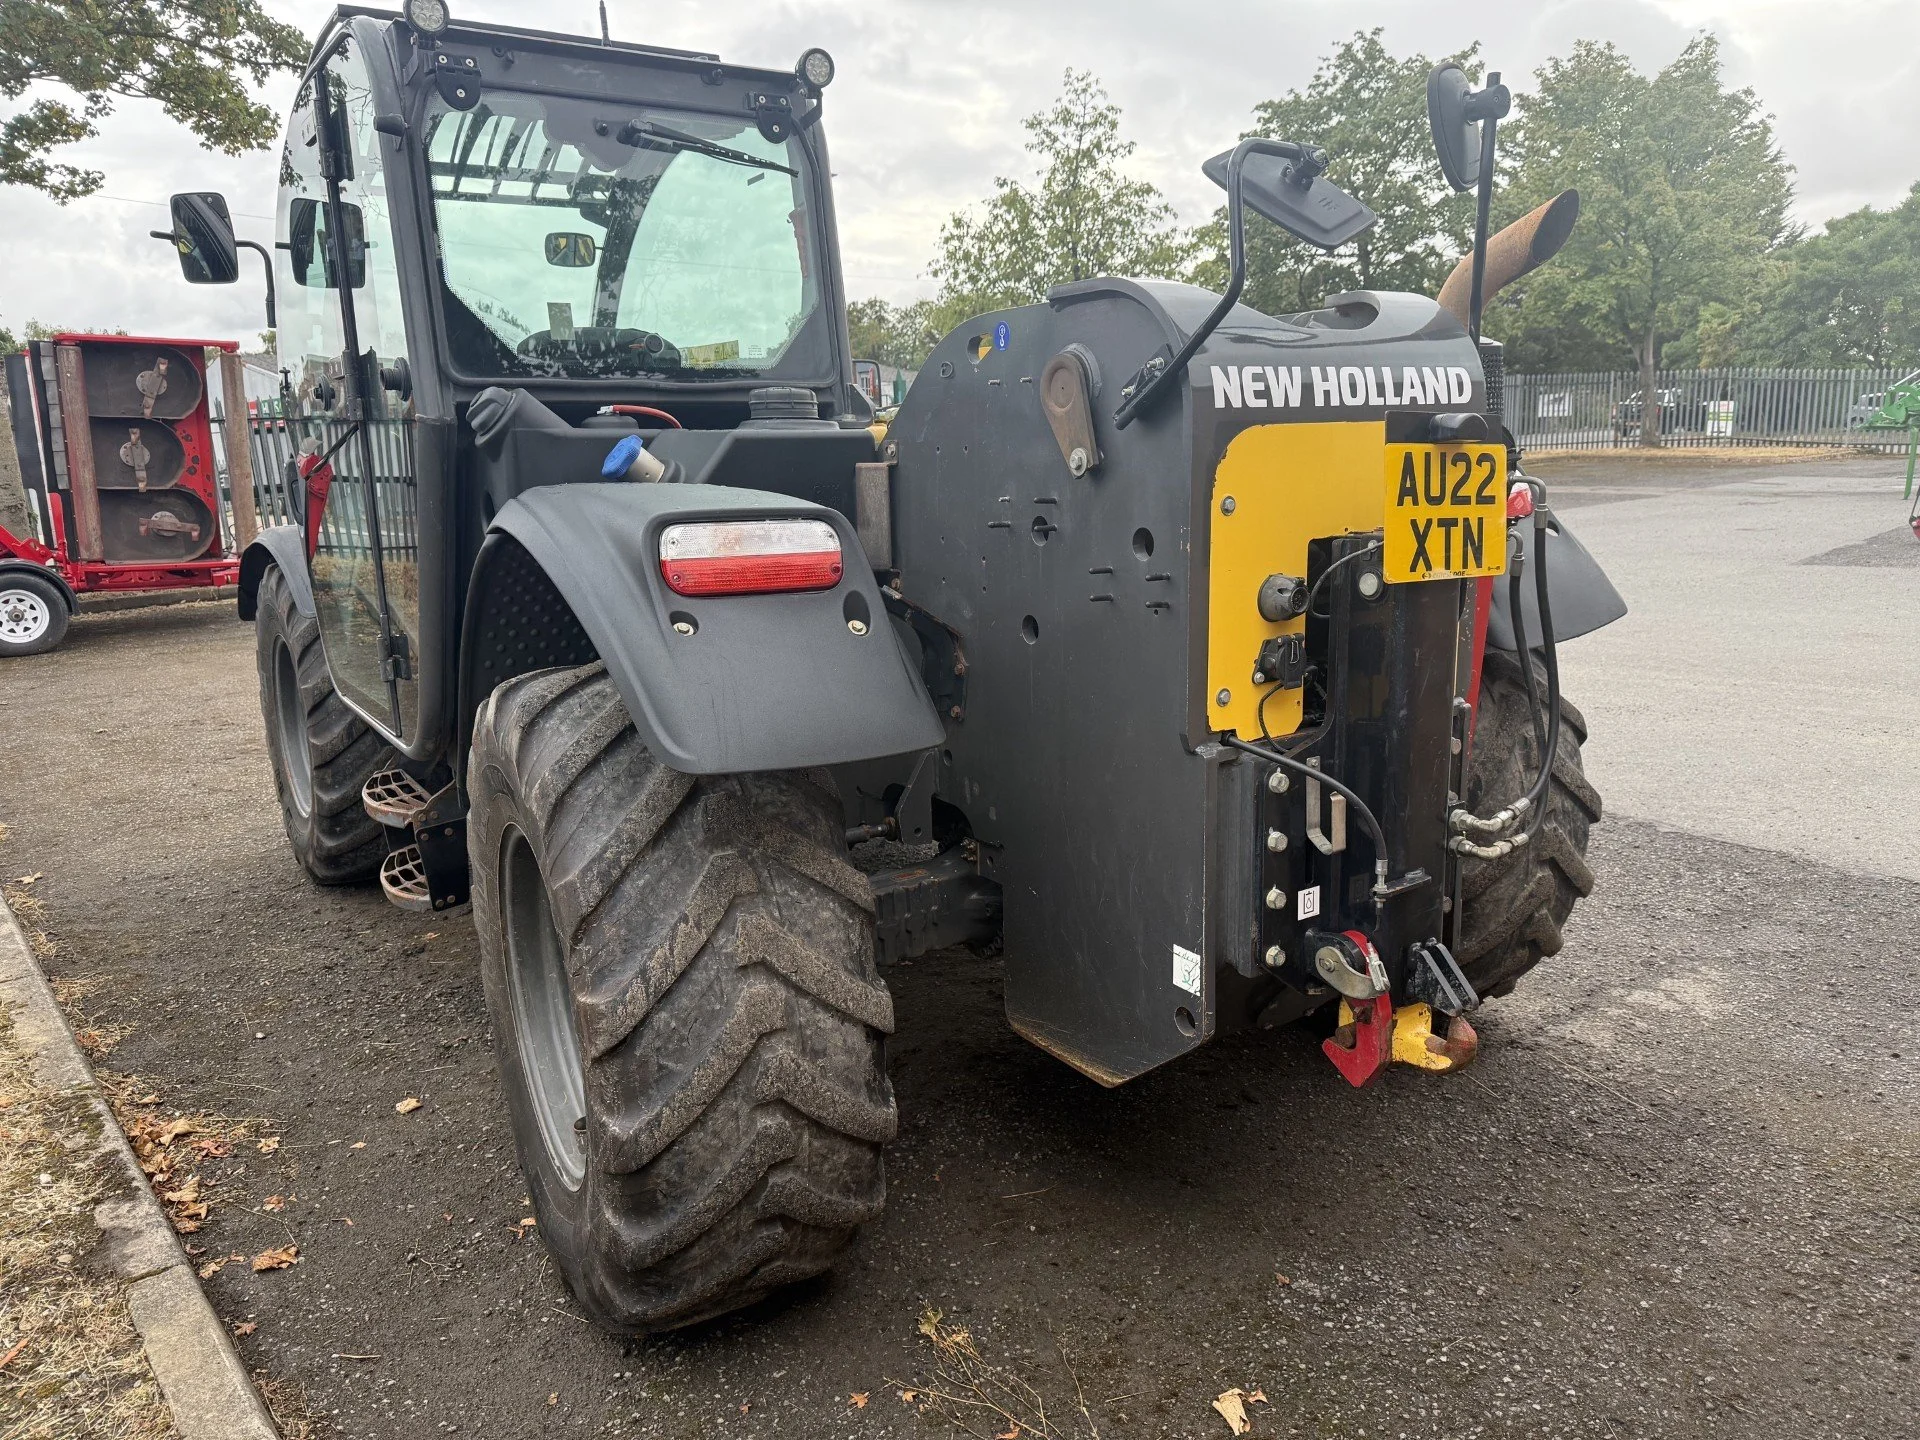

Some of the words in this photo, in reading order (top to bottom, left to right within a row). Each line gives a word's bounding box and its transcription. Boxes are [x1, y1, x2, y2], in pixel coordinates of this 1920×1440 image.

[1210, 365, 1301, 408] NEW
[1310, 366, 1472, 407] HOLLAND
[1396, 451, 1496, 507] AU22
[1409, 516, 1483, 573] XTN
